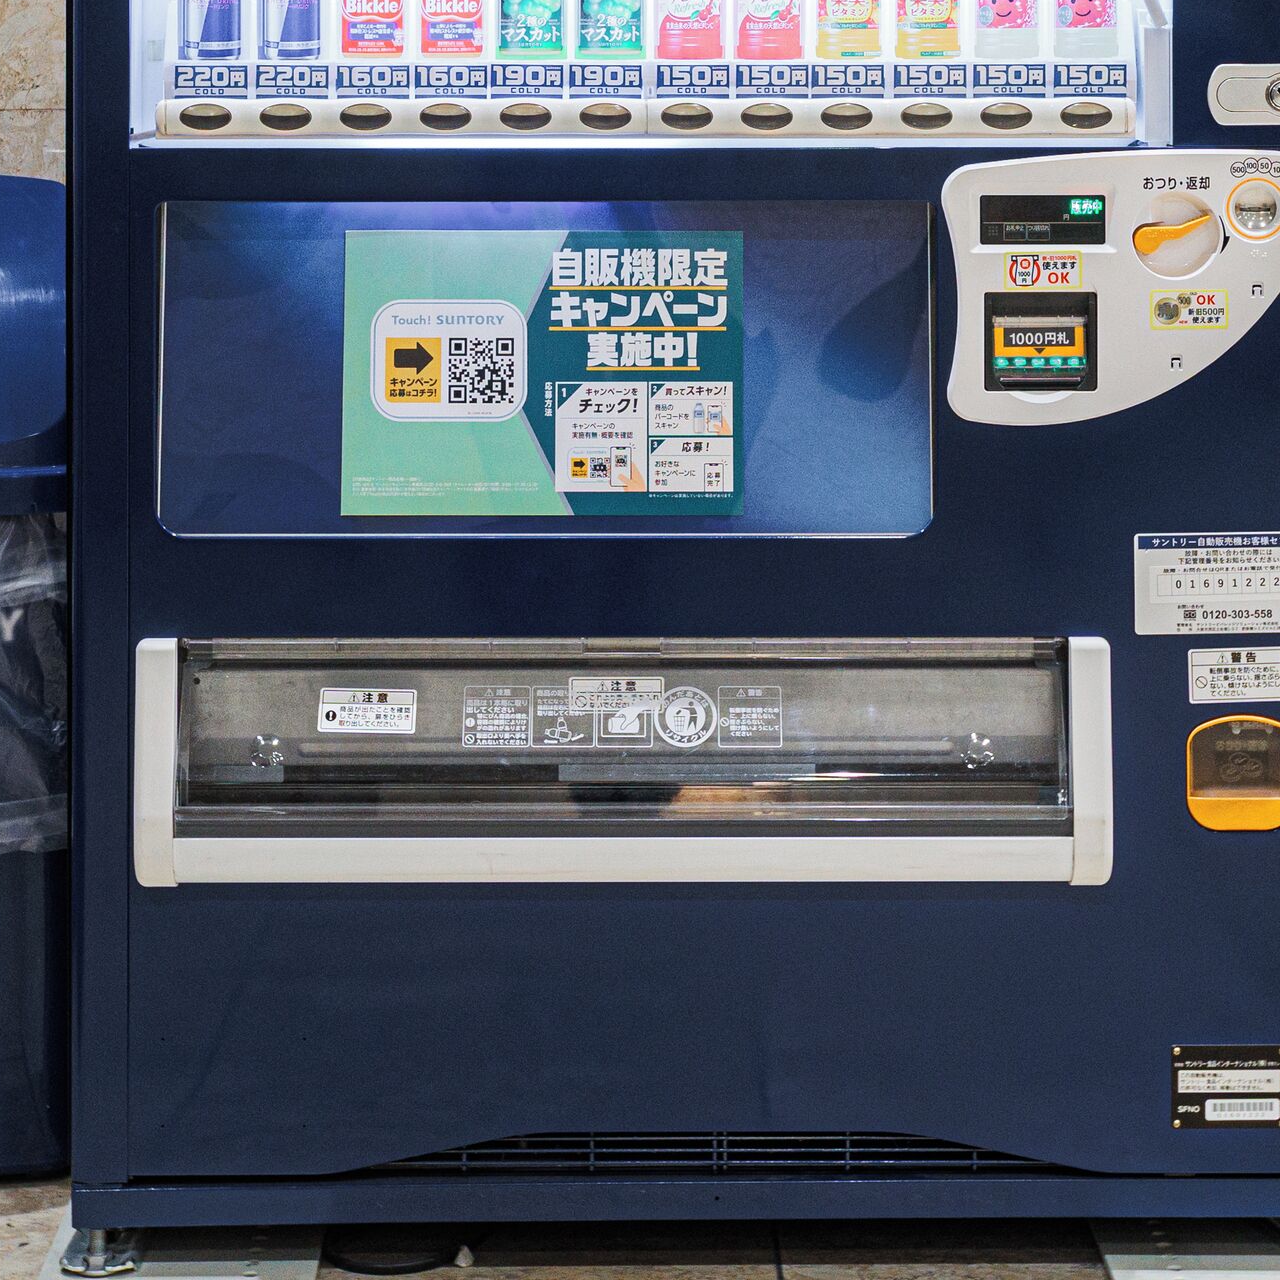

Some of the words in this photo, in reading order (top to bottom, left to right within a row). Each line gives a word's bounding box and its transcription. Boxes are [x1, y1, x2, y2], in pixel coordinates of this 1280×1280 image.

[501, 27, 560, 42] マスカット
[178, 67, 244, 85] 220円
[259, 67, 325, 85] 220円
[340, 67, 406, 85] 160円
[418, 67, 484, 85] 160円
[494, 67, 560, 85] 190円
[573, 67, 639, 85] 190円
[660, 66, 724, 85] 150円
[739, 66, 803, 85] 150円
[815, 66, 881, 85] 150円
[897, 66, 963, 85] 150円
[976, 66, 1043, 84] 150円
[1057, 66, 1123, 84] 150円
[1143, 177, 1210, 190] おつり・返却
[1071, 199, 1102, 215] 販売中
[551, 248, 728, 287] 自販機限定
[1042, 262, 1077, 270] 使えます
[1048, 272, 1070, 284] OK
[1196, 295, 1216, 305] OK
[549, 291, 727, 328] キャンペーン
[392, 315, 431, 325] Touch!
[436, 315, 504, 325] SUNTORY
[1192, 316, 1221, 324] 使えます
[1008, 331, 1070, 346] 1000円札
[587, 332, 698, 367] 実施中!
[390, 378, 437, 387] キャンペーン
[390, 388, 437, 397] 応募はコチラ!
[585, 388, 638, 396] キャンペーンを
[665, 386, 727, 396] 買ってスキャン!
[544, 382, 553, 417] 応募方法
[579, 398, 638, 413] チェック!
[681, 442, 710, 452] 応募!
[1202, 609, 1273, 620] 0120-303-558
[1231, 652, 1257, 663] 警告
[362, 693, 389, 703] 注意
[665, 729, 707, 743] リサイクル
